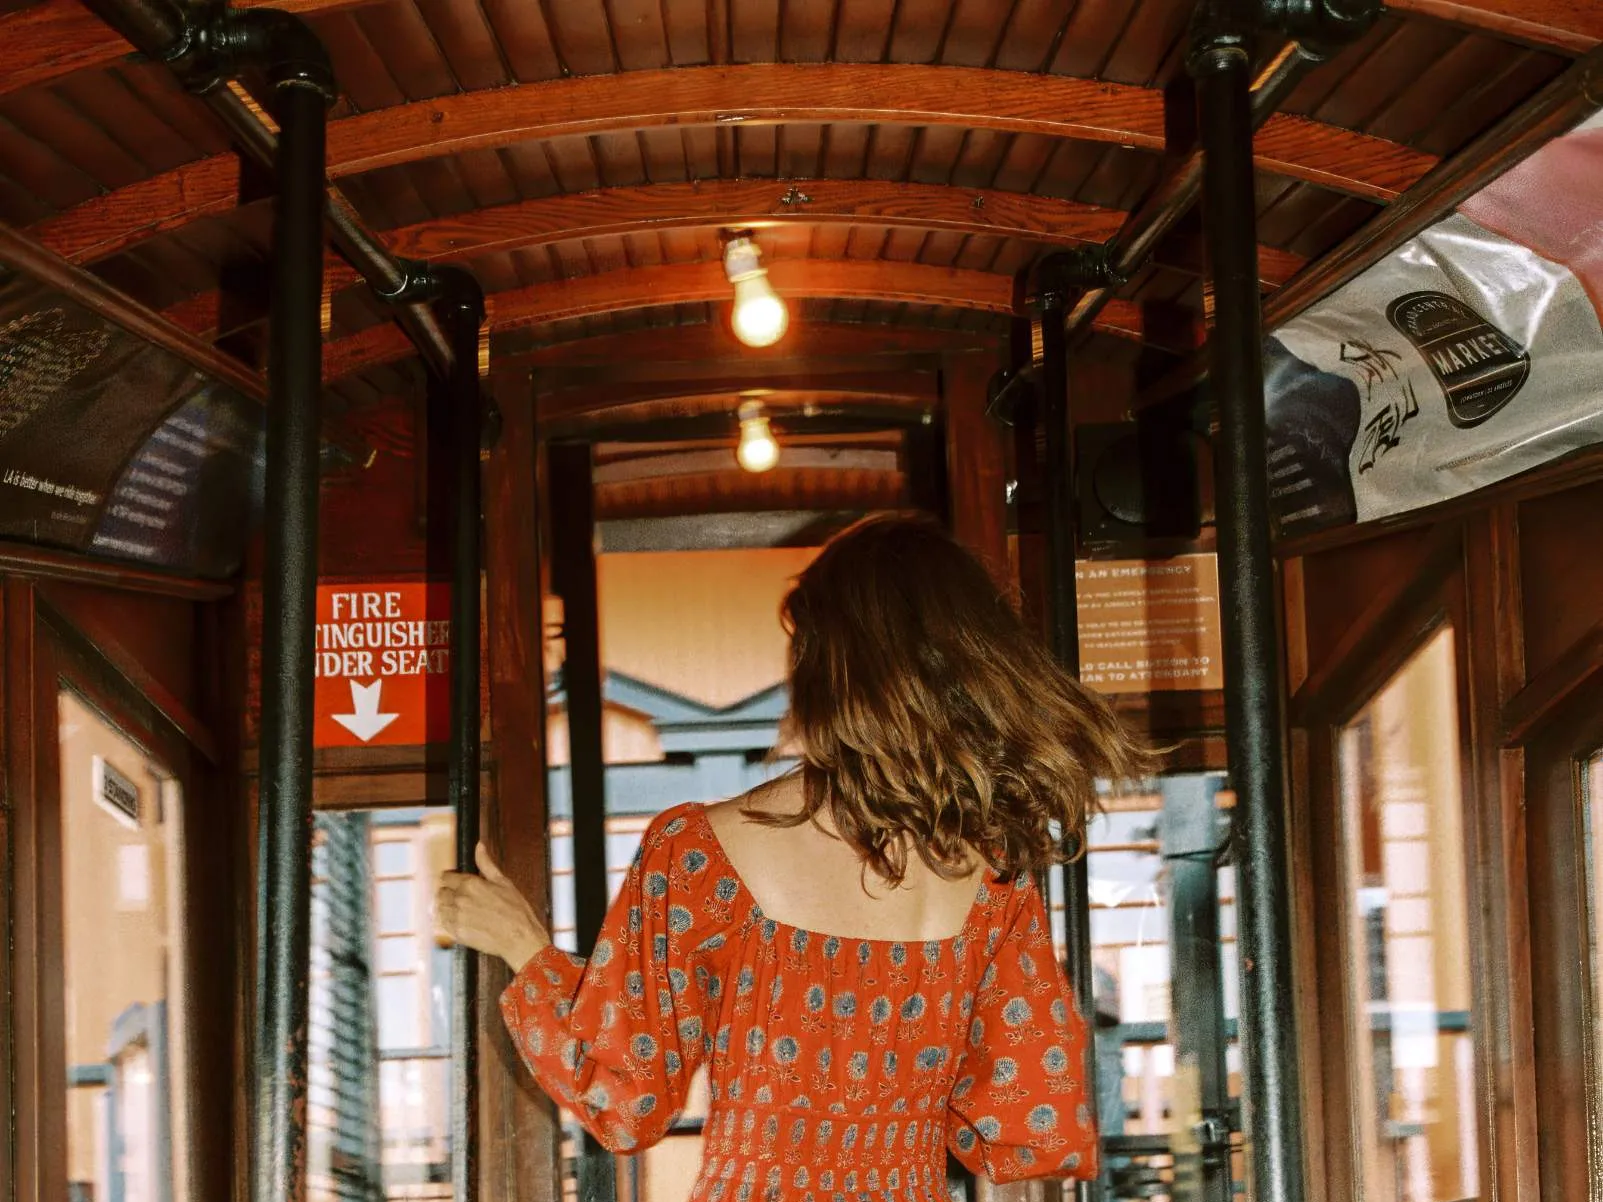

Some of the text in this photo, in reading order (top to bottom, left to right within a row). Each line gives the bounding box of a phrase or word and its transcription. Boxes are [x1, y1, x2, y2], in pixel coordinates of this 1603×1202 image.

[1431, 333, 1511, 376] MARKET
[3, 467, 15, 484] LA
[13, 470, 20, 486] is
[19, 472, 39, 490] better
[38, 478, 55, 494] when
[1089, 568, 1108, 579] AN
[1112, 565, 1191, 578] EMERGENCY
[332, 592, 401, 620] FIRE
[380, 649, 449, 676] SEAT
[1098, 661, 1132, 671] CALL
[1108, 671, 1125, 682] TO
